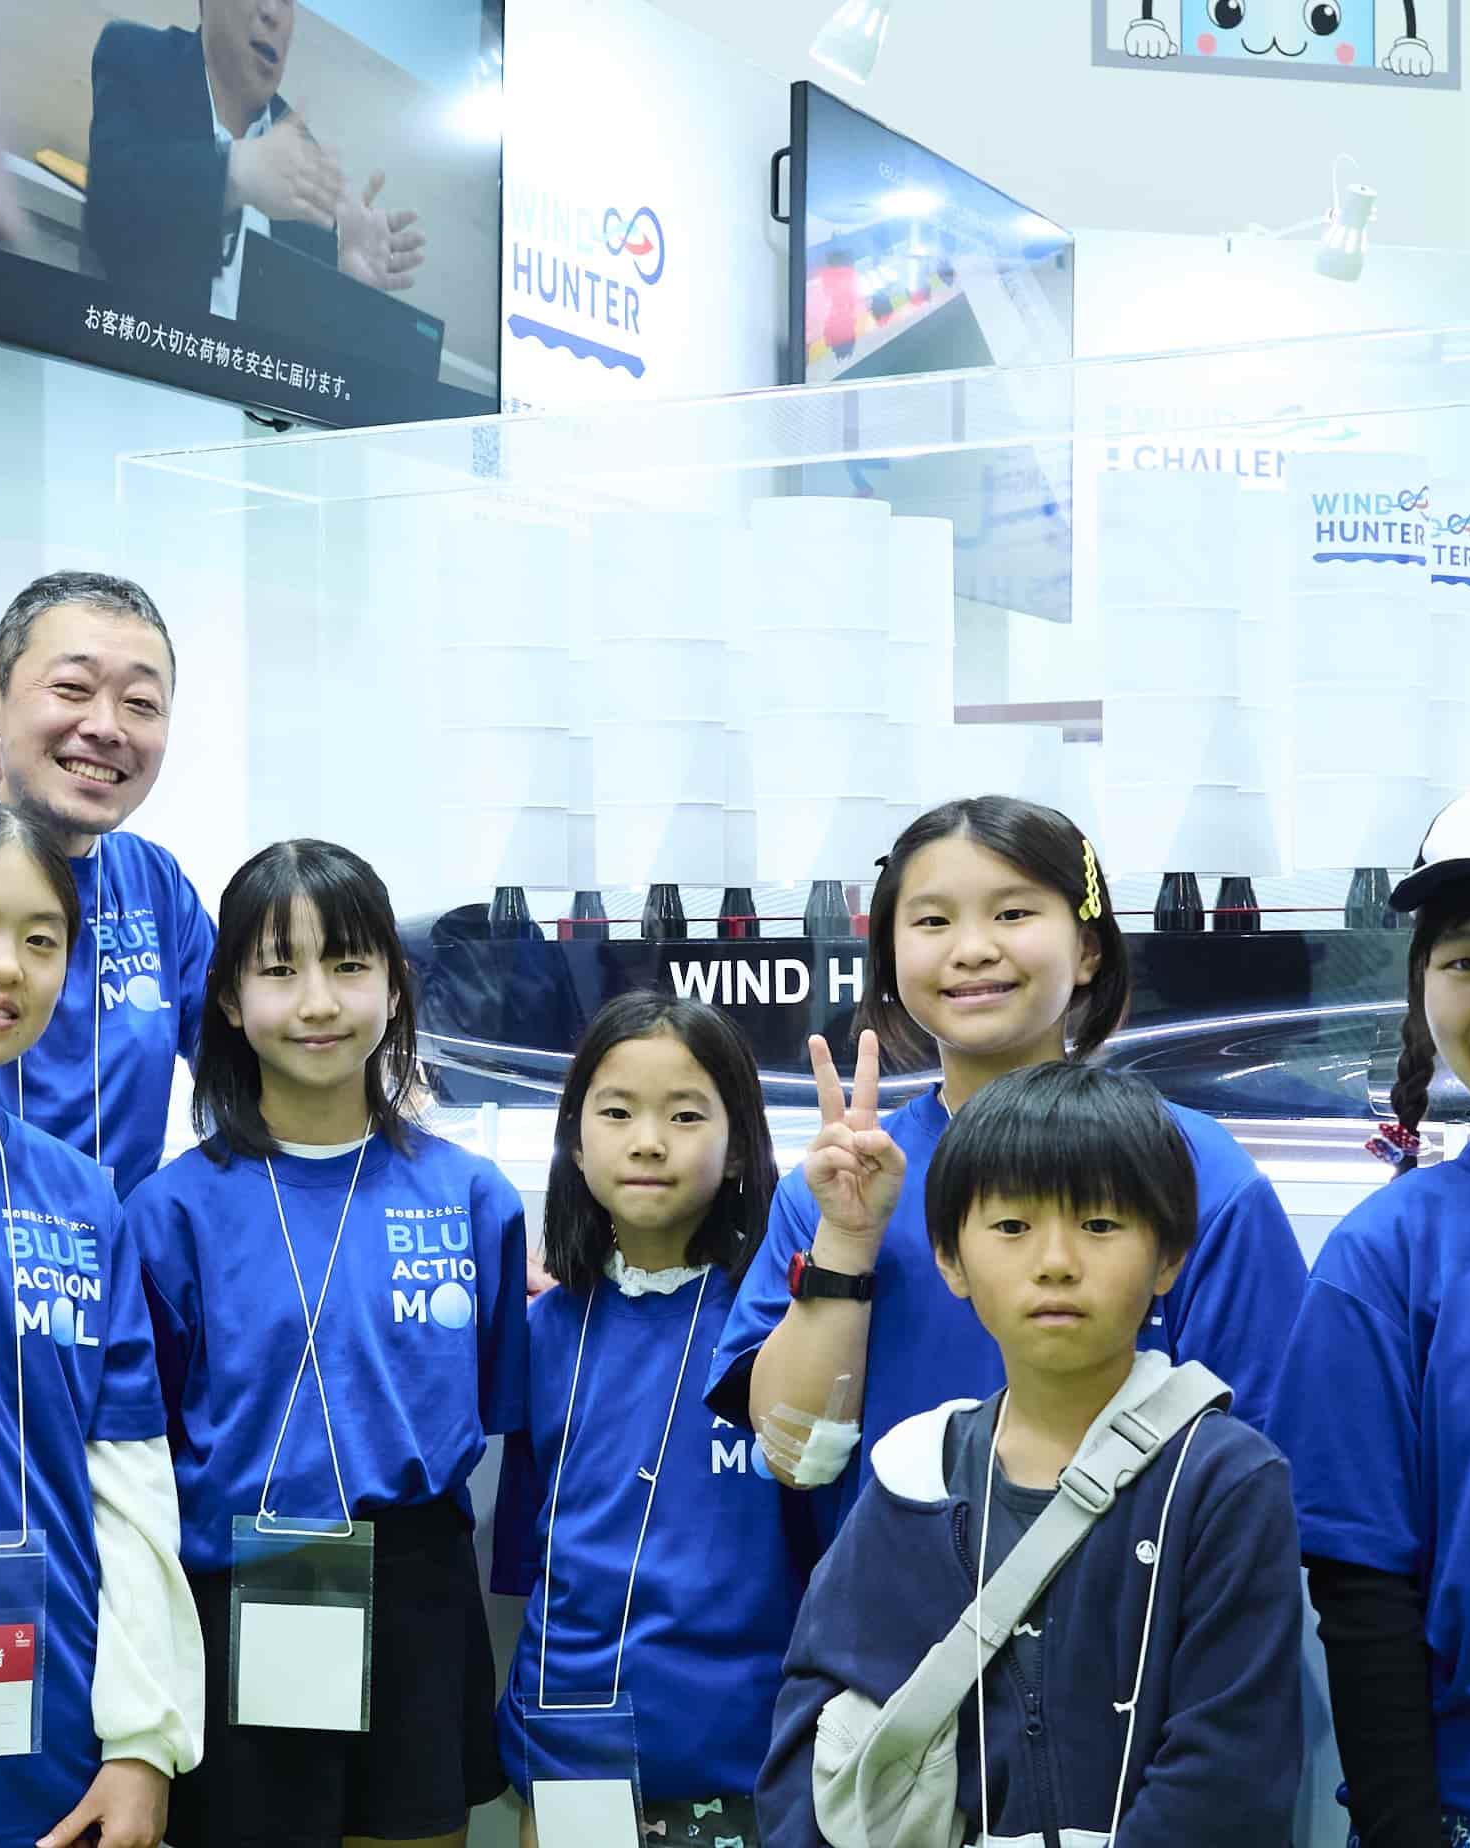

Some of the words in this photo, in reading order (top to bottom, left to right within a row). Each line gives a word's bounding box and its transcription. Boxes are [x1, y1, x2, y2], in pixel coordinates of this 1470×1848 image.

[513, 242, 640, 335] HUNTER
[84, 304, 351, 401] お客様の大切な荷物を安全に届けます。
[1312, 492, 1395, 516] WIND
[1315, 519, 1426, 546] HUNTER
[669, 958, 810, 1005] WIND
[4, 1226, 100, 1273] BLUE
[14, 1266, 102, 1301] ACTION
[15, 1296, 100, 1347] MOL
